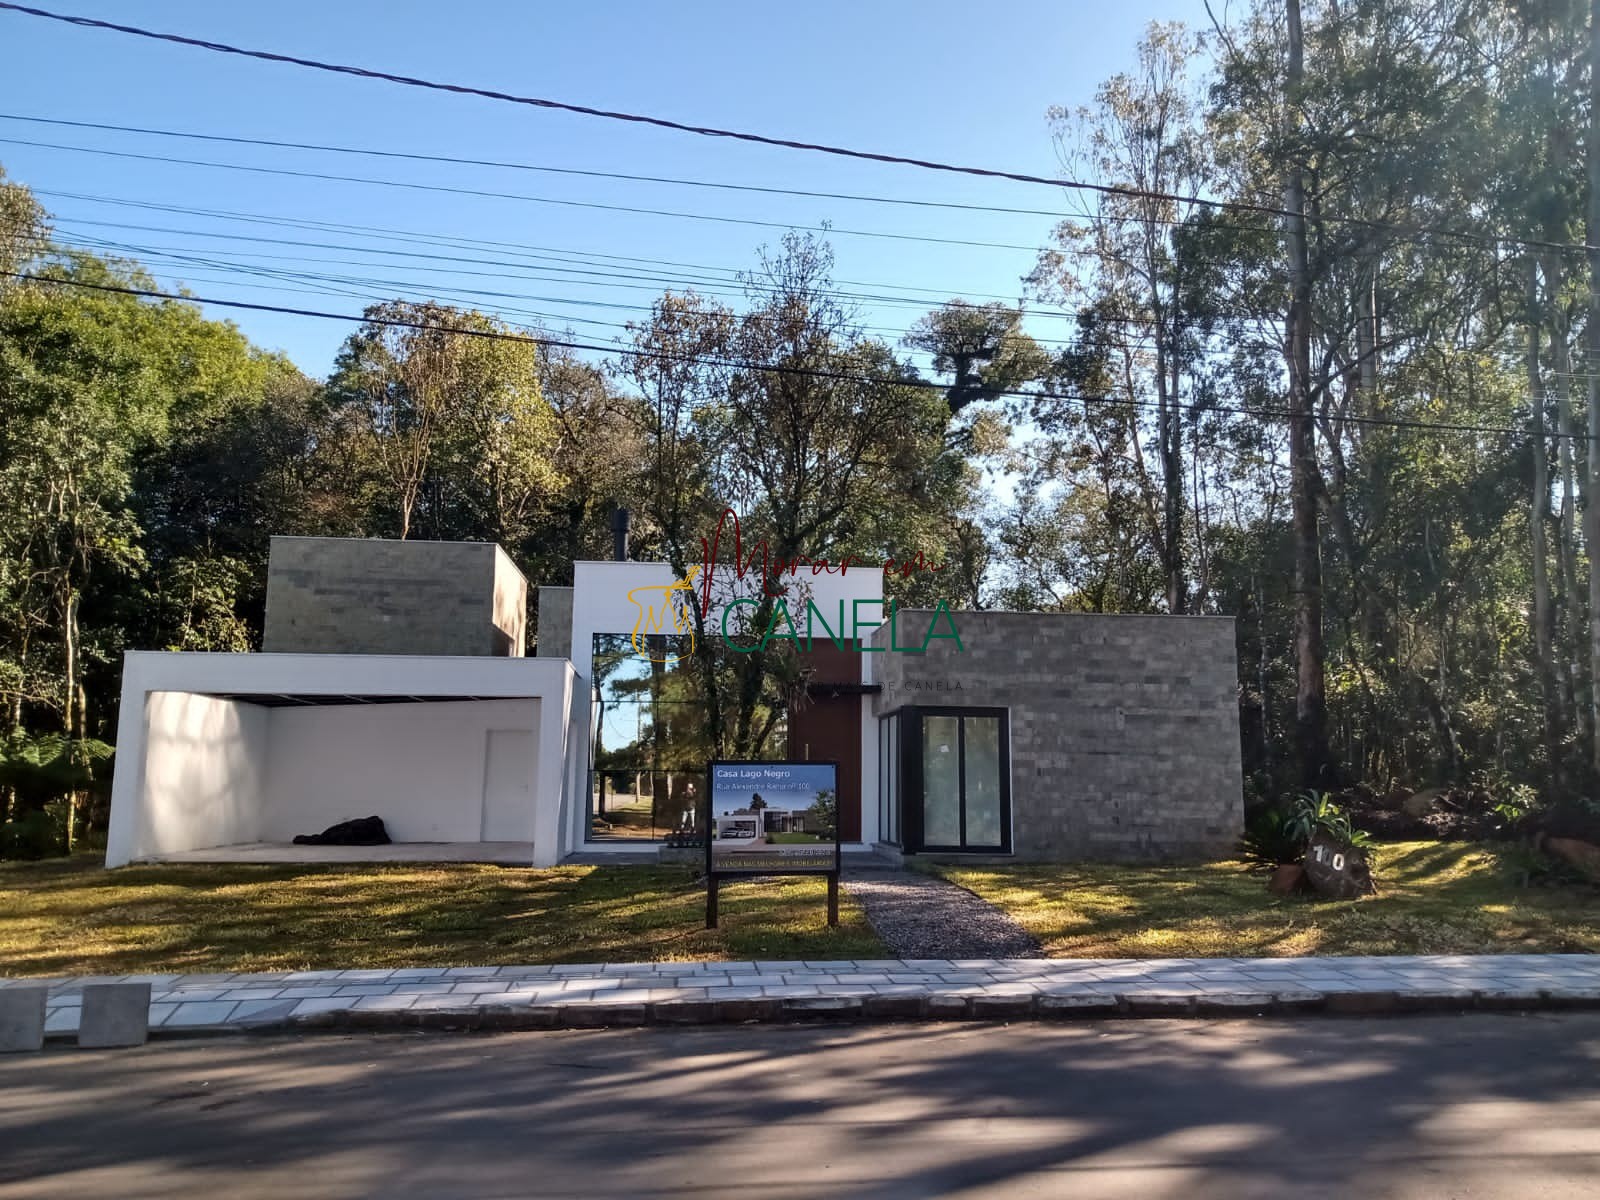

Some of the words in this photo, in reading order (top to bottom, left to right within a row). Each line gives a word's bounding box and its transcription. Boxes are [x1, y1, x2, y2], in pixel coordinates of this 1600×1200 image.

[717, 770, 738, 778] Casa
[740, 770, 762, 779] Lago
[764, 770, 791, 779] Negro
[1313, 845, 1345, 871] 100
